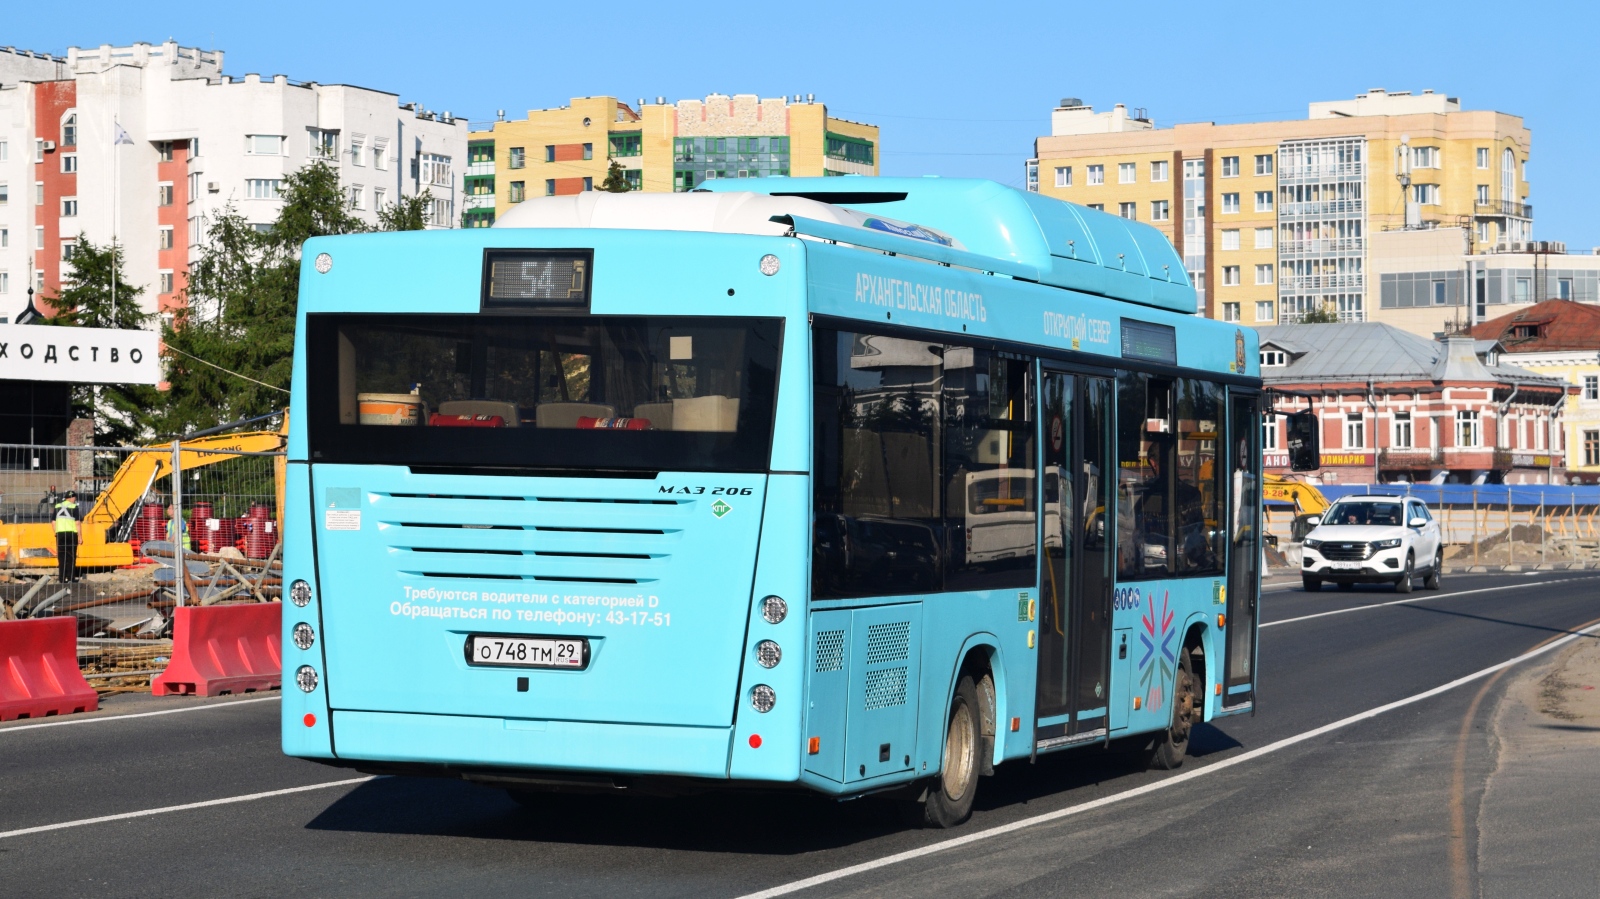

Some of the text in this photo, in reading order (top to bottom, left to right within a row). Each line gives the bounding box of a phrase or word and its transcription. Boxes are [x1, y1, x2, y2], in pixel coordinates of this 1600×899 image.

[520, 261, 555, 298] 54
[855, 272, 987, 322] АРХАНГЕЛЬСКАЯ ОБЛАСТЬ
[1043, 311, 1111, 344] ОТКРЫТЫЙ СЕВЕР
[1264, 455, 1365, 466] АНО УЛИНАРИЯ
[658, 485, 754, 495] МАЗ 206
[403, 586, 659, 610] Требуются водители с категорией D
[389, 601, 671, 627] Обращаться по телефону: 43-17-51
[557, 643, 575, 658] 29
